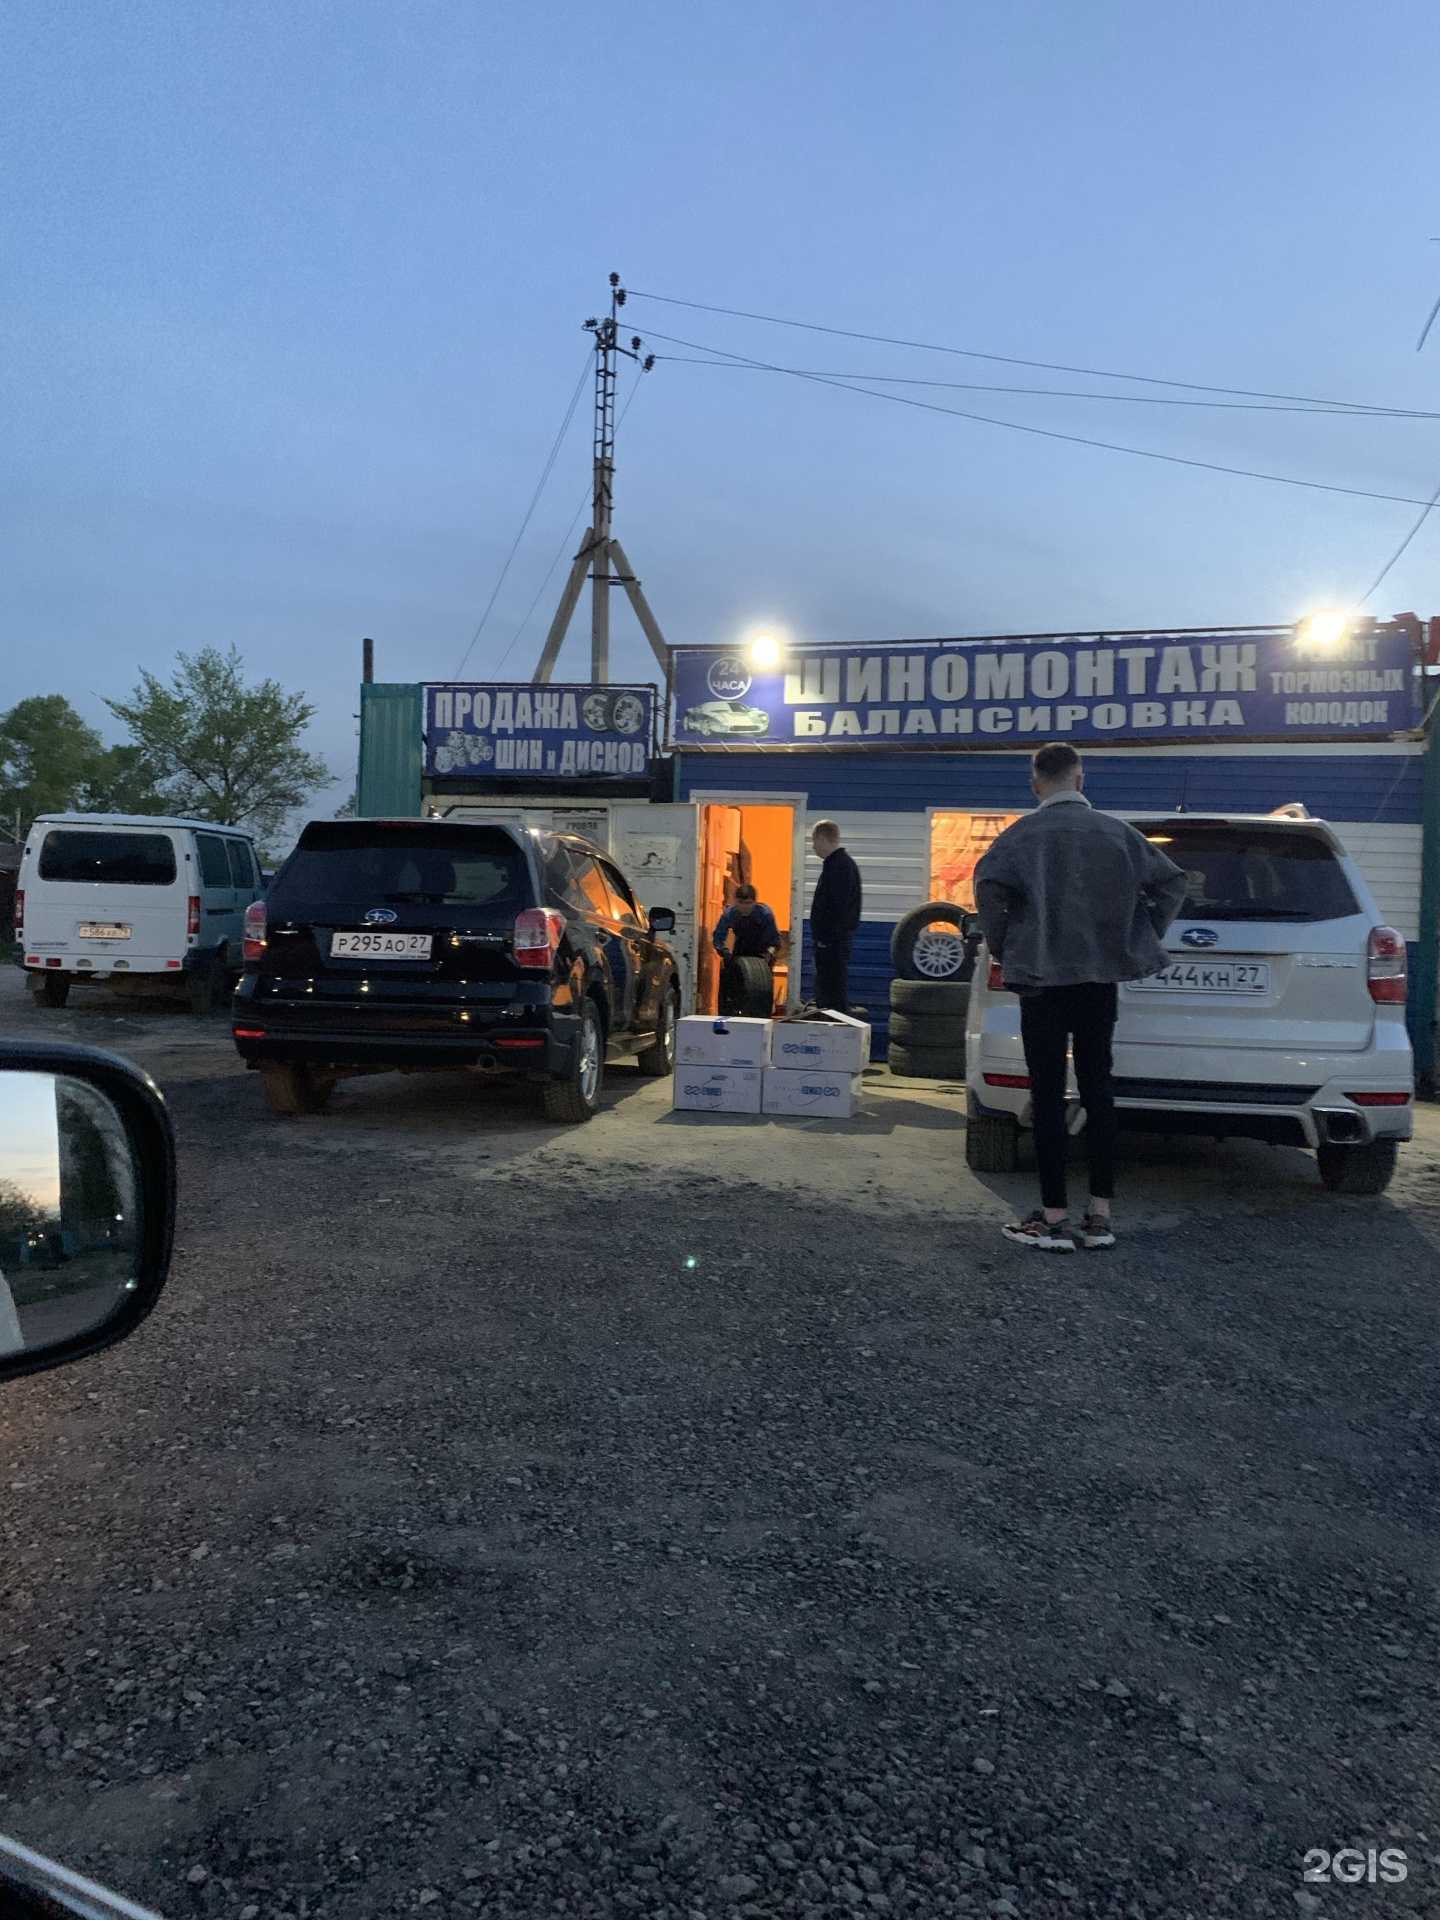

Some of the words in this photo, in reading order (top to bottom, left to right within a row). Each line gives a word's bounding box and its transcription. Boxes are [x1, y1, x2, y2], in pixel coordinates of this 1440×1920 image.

[719, 660, 740, 676] 24
[784, 644, 1257, 704] ШИНОМОНТАЖ
[1270, 669, 1404, 694] ТОРМОЗНЫХ
[712, 680, 746, 691] ЧАСА
[434, 692, 578, 734] ПРОДАЖА
[794, 700, 1245, 737] БАЛАНСИРОВКА
[1284, 701, 1389, 727] КОЛОДОК
[495, 739, 543, 769] ШИН
[559, 740, 645, 774] ДИСКОВ
